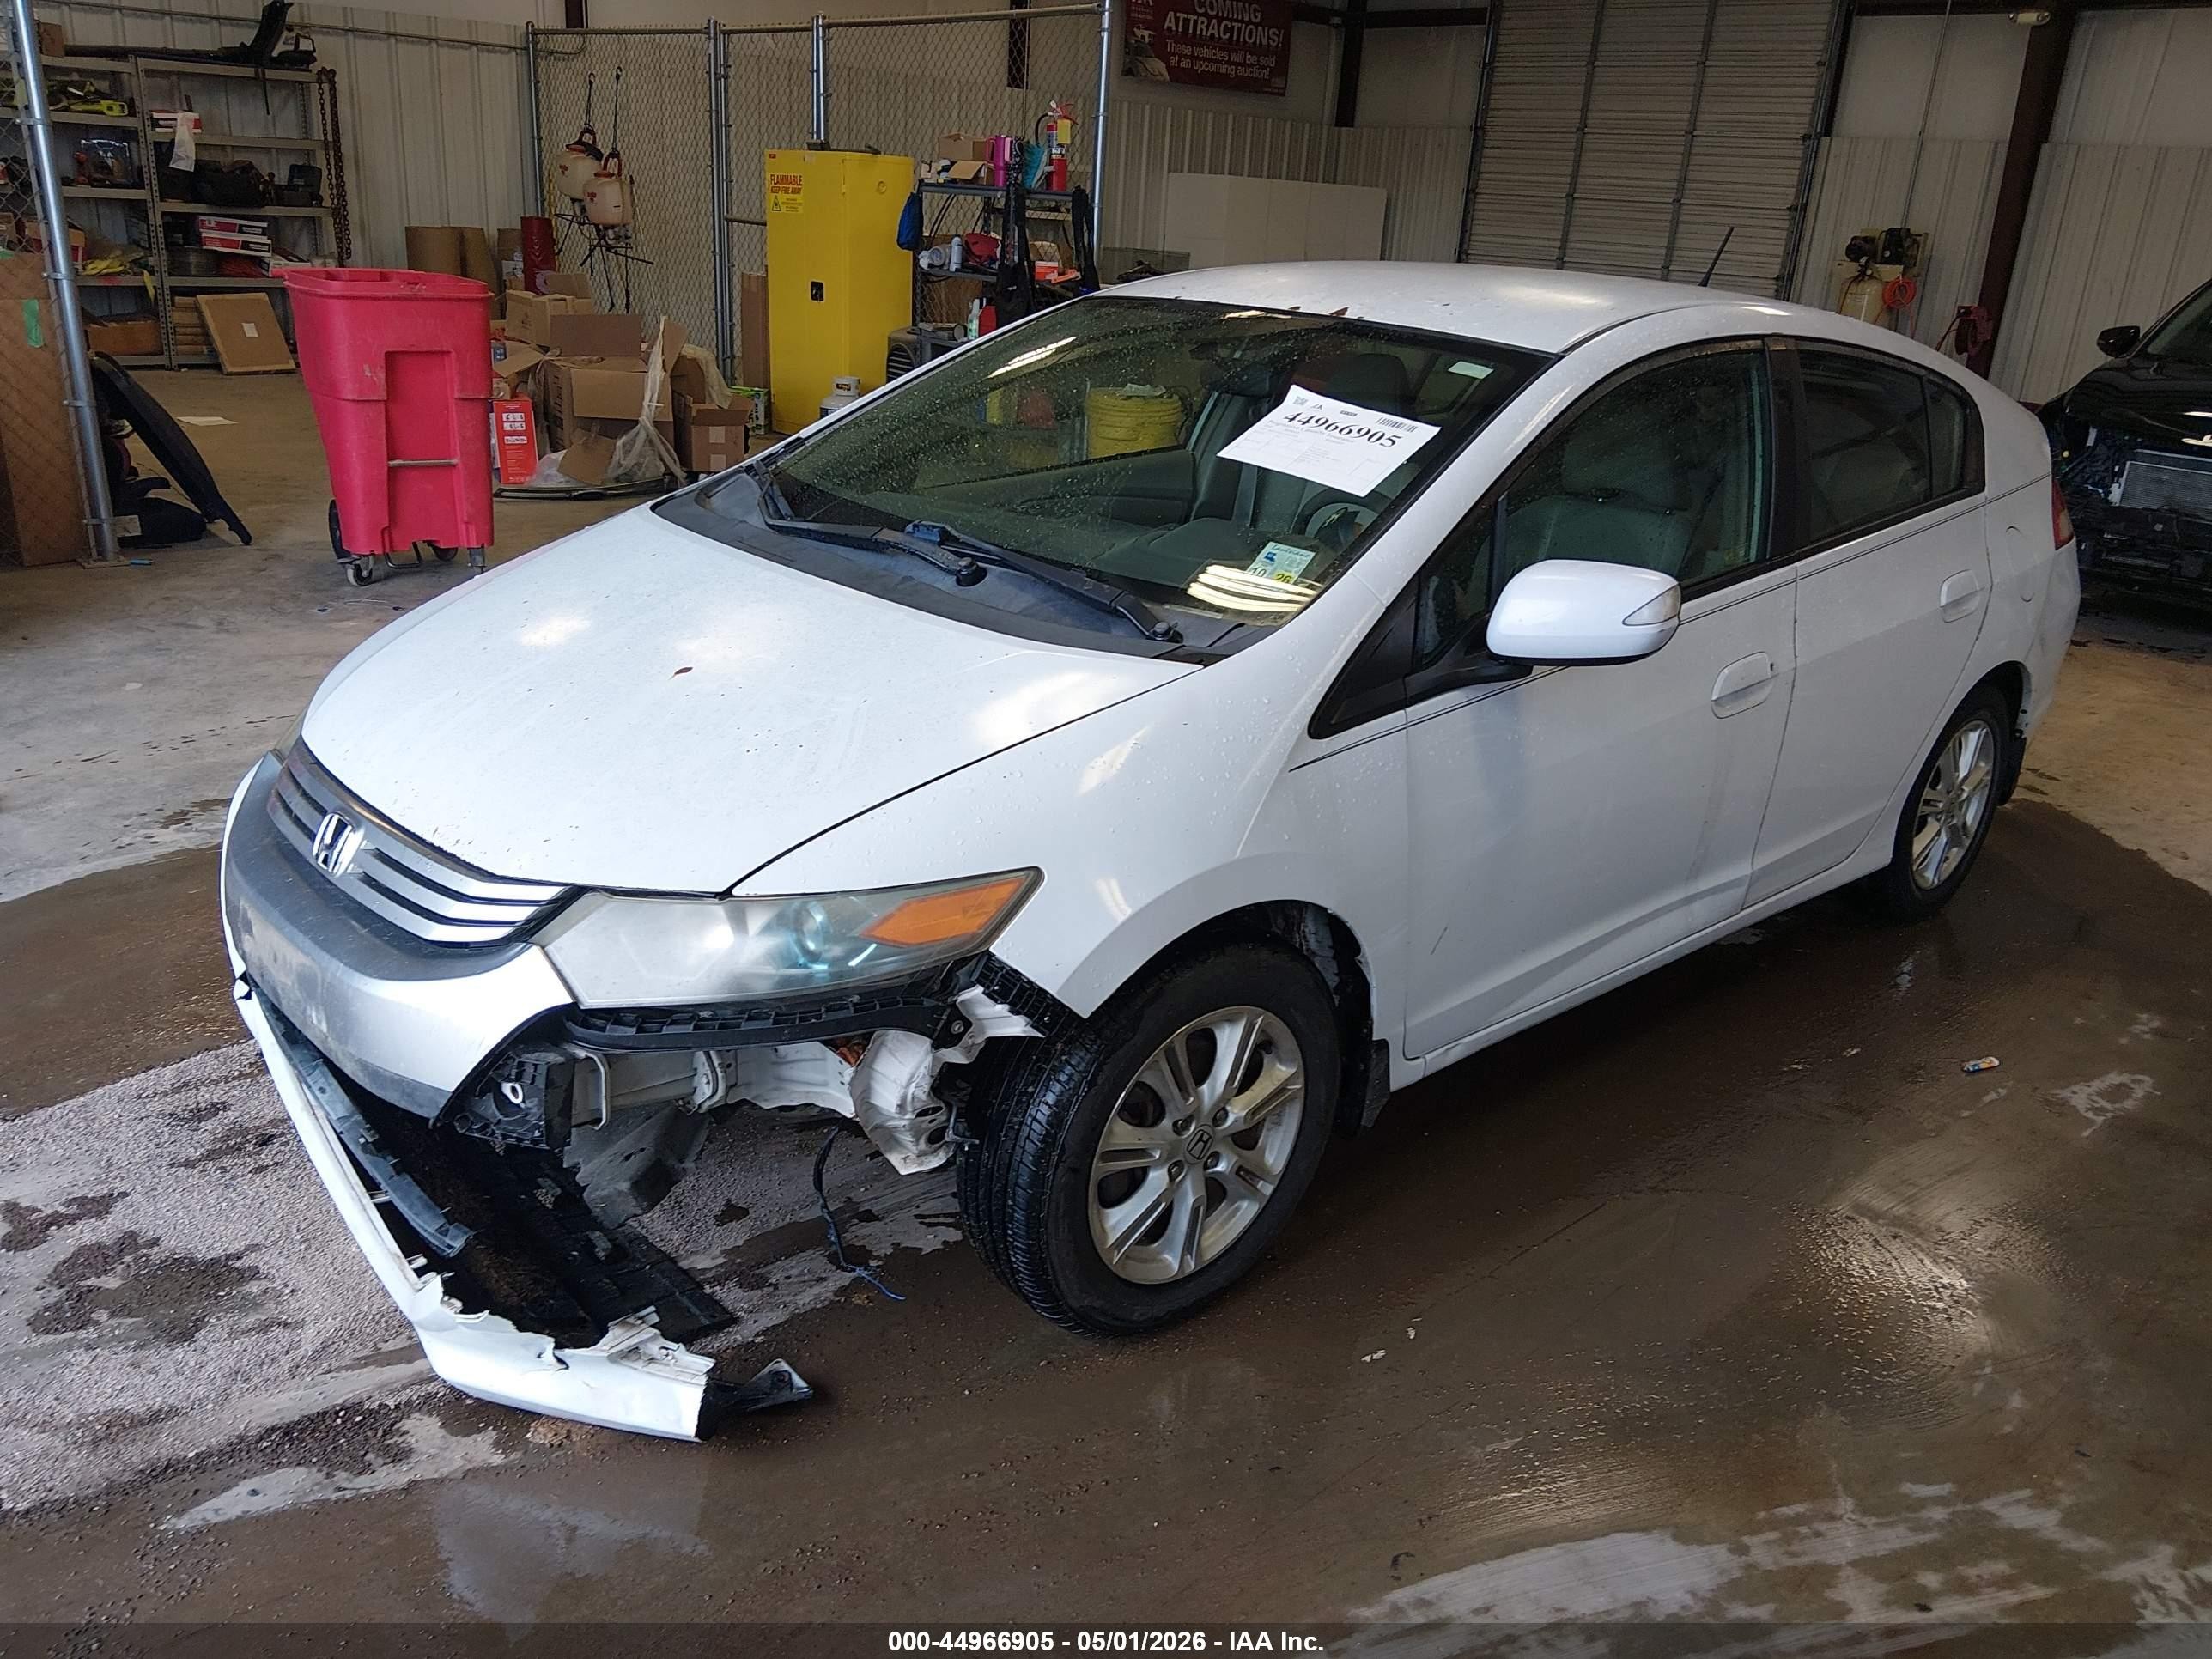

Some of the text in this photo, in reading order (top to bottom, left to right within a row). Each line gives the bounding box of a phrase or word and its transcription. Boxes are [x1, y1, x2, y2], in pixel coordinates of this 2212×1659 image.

[1194, 0, 1262, 23] COMING
[1164, 11, 1285, 47] ATTRACTIONS!
[1166, 40, 1276, 67] These vehicles will be sold
[1170, 56, 1271, 79] at an upcoming auction!
[1283, 412, 1402, 447] 44966905
